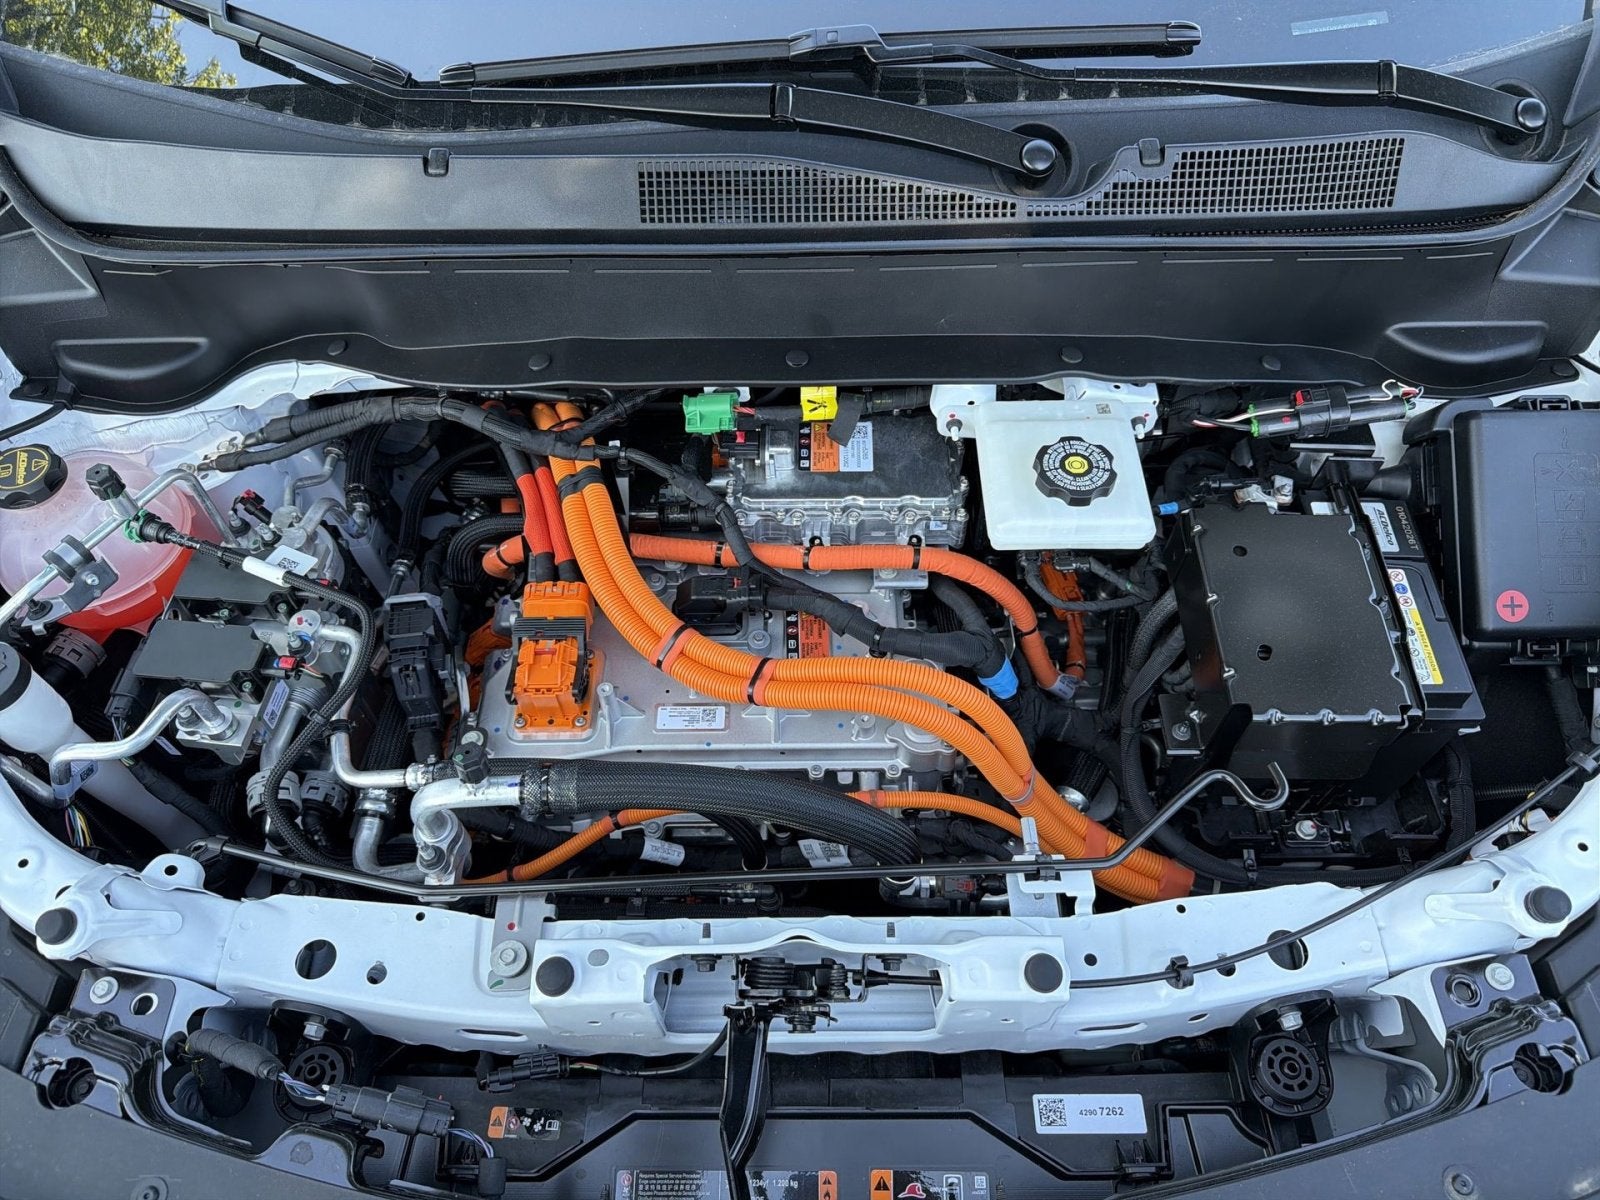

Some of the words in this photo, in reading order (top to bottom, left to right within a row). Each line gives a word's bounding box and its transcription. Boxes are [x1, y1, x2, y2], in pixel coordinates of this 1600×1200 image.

[1376, 508, 1395, 546] ACDelco
[1099, 1106, 1124, 1116] 7262
[790, 1180, 799, 1189] kg
